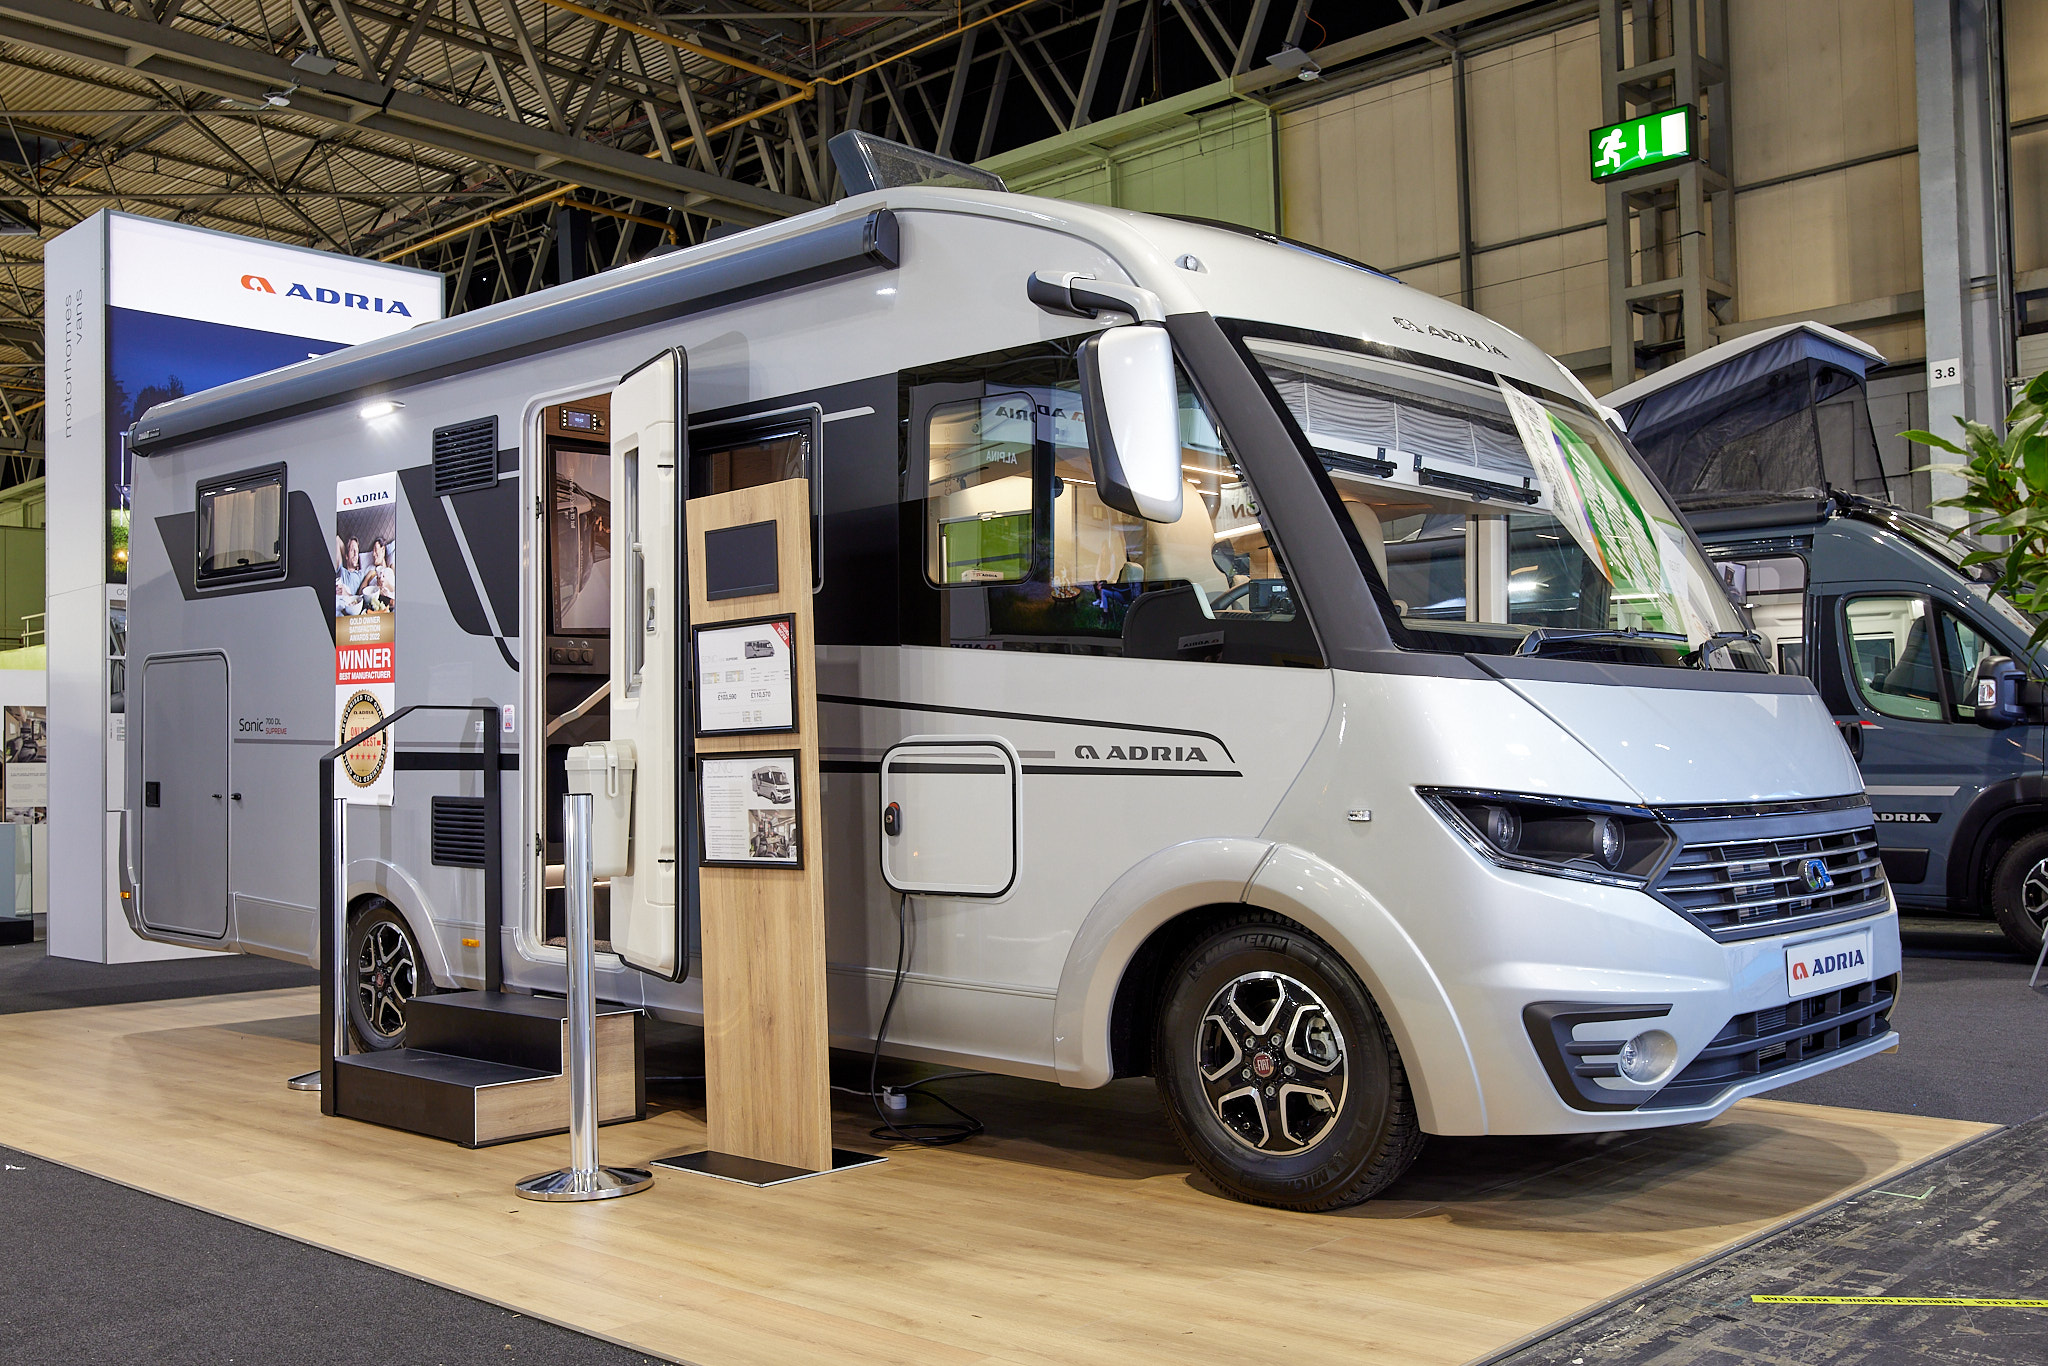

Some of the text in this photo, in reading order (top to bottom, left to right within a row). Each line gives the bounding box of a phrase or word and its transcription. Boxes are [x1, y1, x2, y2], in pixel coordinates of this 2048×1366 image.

[285, 283, 412, 317] ADRIA
[75, 288, 83, 345] vans
[1426, 324, 1511, 360] ADRIA
[64, 294, 73, 438] motorhomes
[1935, 367, 1956, 379] 3.8
[355, 491, 389, 505] ADRIA
[349, 616, 380, 625] GOLD OWNER
[349, 625, 380, 633] SATISFACTION
[339, 648, 391, 670] WINNER
[339, 670, 391, 680] BEST MANUFACTURER
[364, 694, 374, 703] TOP
[239, 718, 264, 732] Sonic
[265, 717, 274, 725] 700
[1106, 746, 1208, 762] ADRIA
[1873, 813, 1932, 822] ADRIA
[1205, 934, 1288, 963] MICHELIN
[1812, 949, 1865, 977] ADRIA
[1257, 1059, 1269, 1072] FIAT
